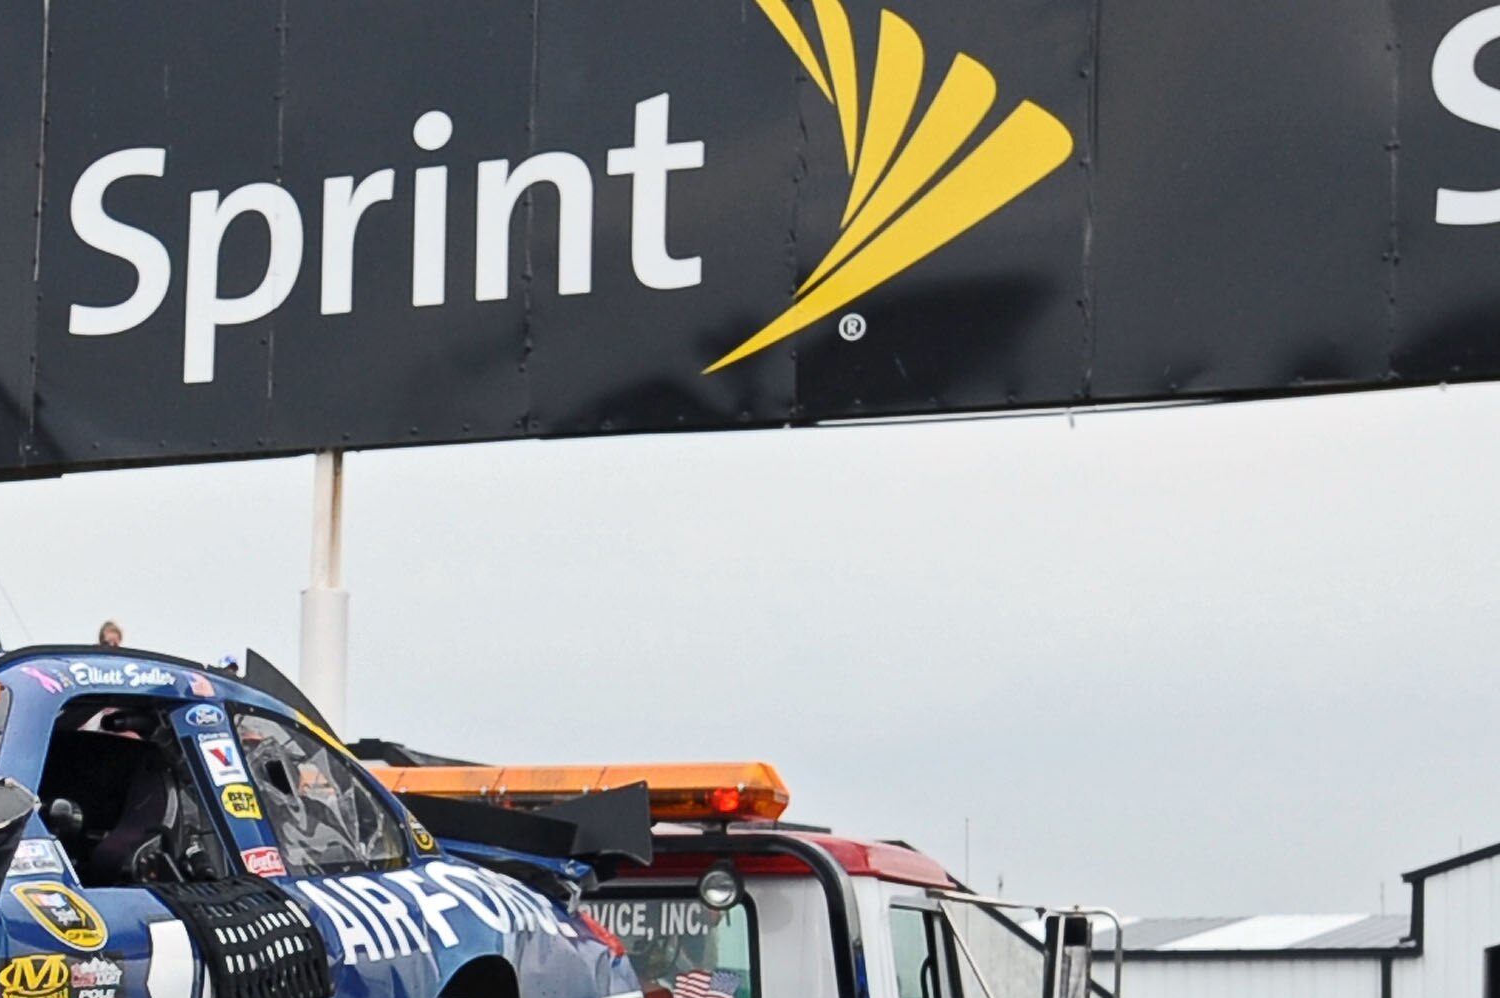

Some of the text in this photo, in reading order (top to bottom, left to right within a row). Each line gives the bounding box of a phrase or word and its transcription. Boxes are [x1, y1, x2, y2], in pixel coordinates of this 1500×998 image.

[68, 93, 705, 384] Sprint
[296, 876, 432, 966] AIR
[660, 902, 709, 936] INC.
